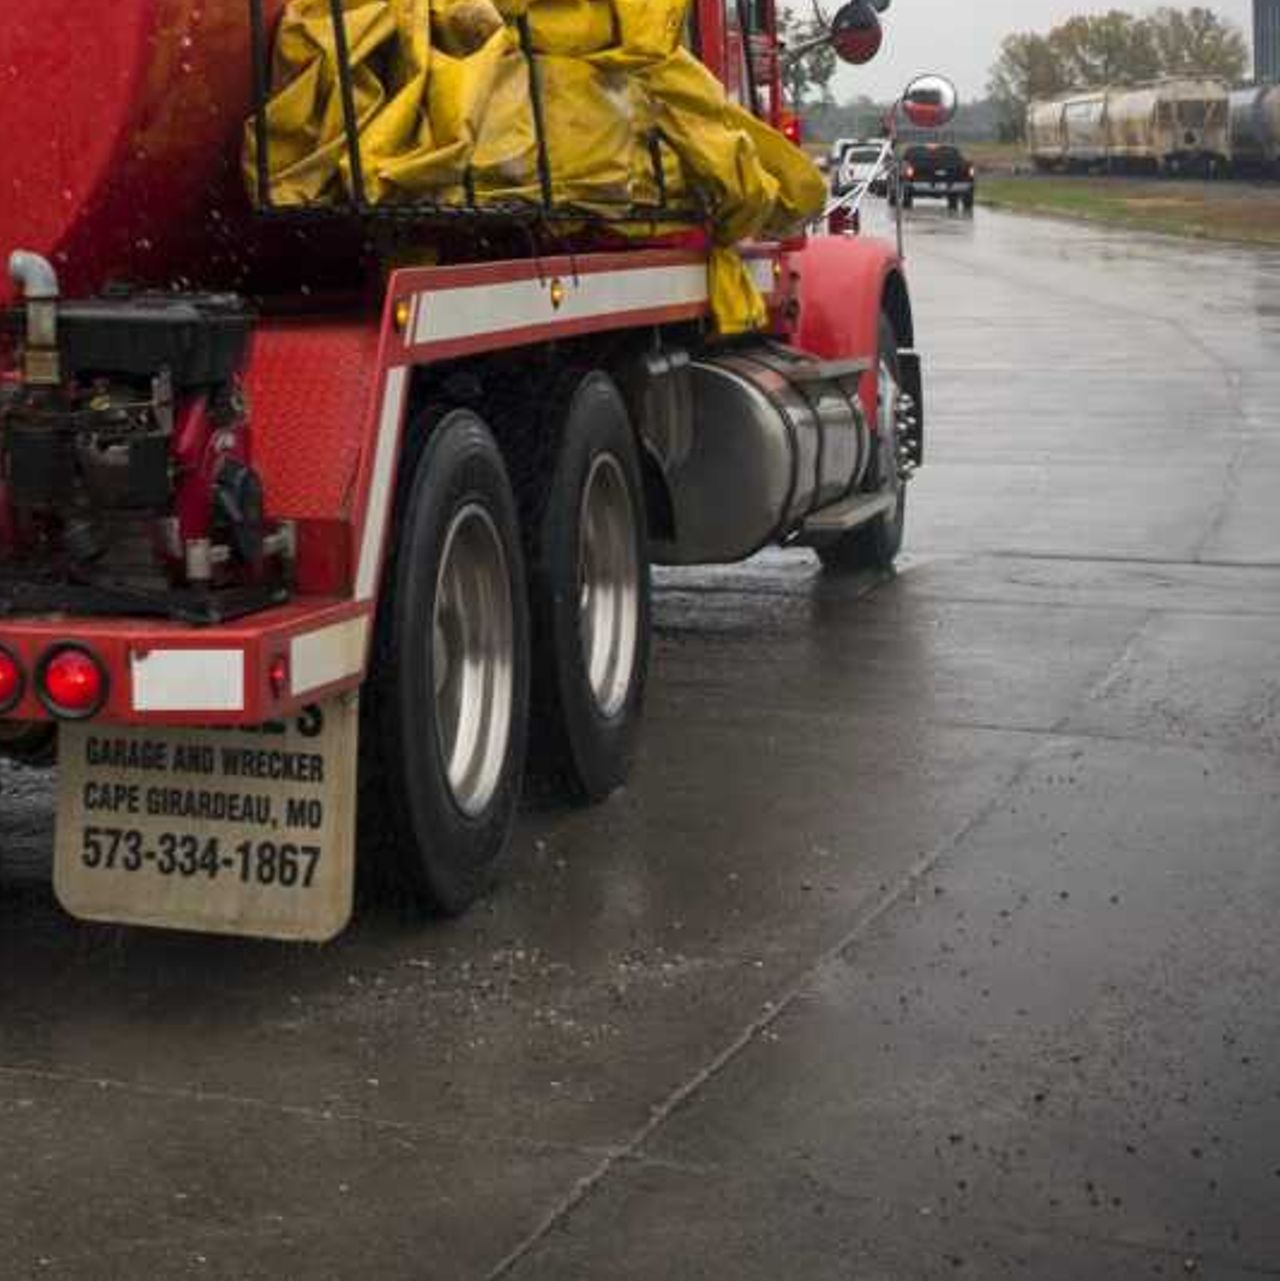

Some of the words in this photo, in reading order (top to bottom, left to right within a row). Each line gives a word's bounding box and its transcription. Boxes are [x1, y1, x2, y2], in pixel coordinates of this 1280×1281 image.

[85, 736, 168, 771] GARAGE
[172, 744, 215, 774] AND
[221, 748, 324, 783] WRECKER
[83, 781, 140, 814] CAPE
[147, 786, 279, 830] GIRARDEAU,
[286, 799, 322, 830] MO
[81, 827, 322, 888] 573-334-1867
